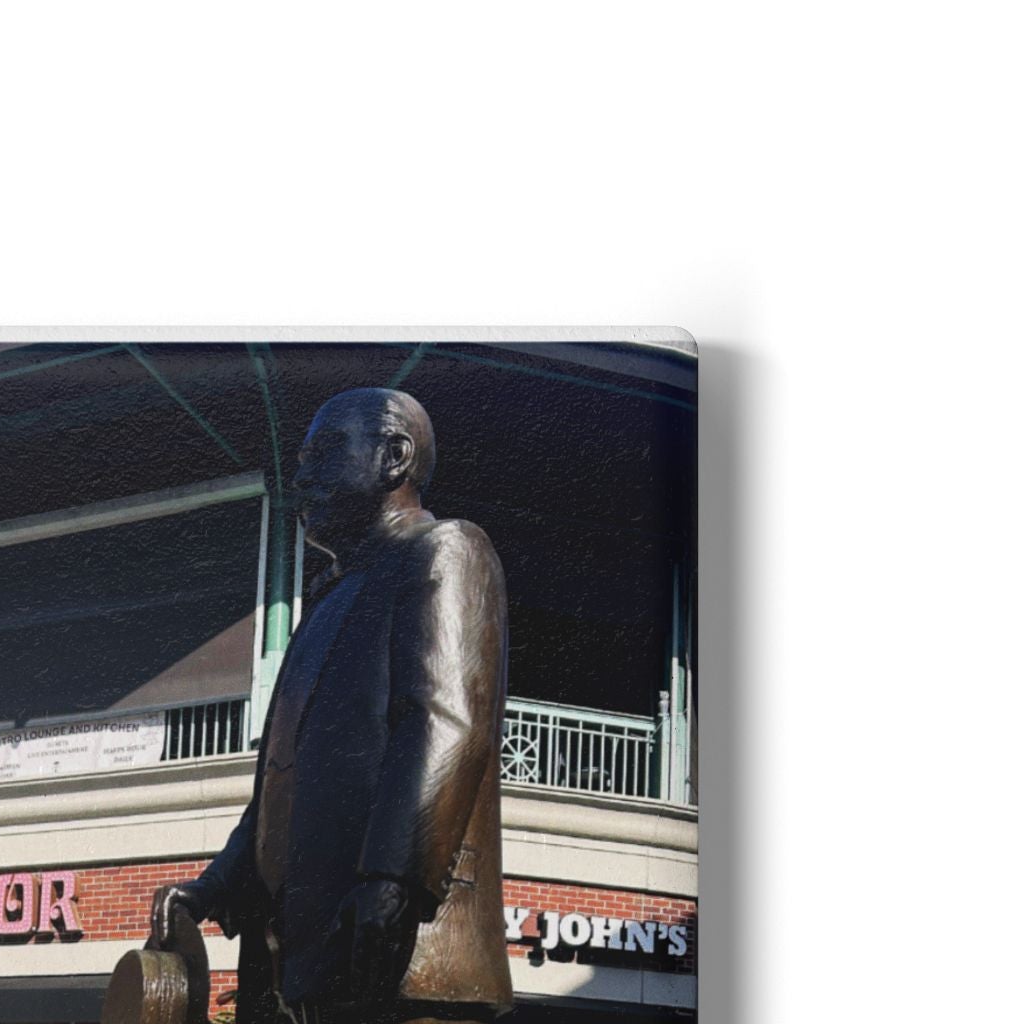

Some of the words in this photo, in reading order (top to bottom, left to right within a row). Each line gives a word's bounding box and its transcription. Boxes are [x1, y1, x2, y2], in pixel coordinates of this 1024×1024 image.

[25, 726, 66, 741] LOUNGE
[68, 723, 91, 735] AND
[93, 722, 140, 734] KITCHEN
[541, 910, 689, 957] JOHN'S
